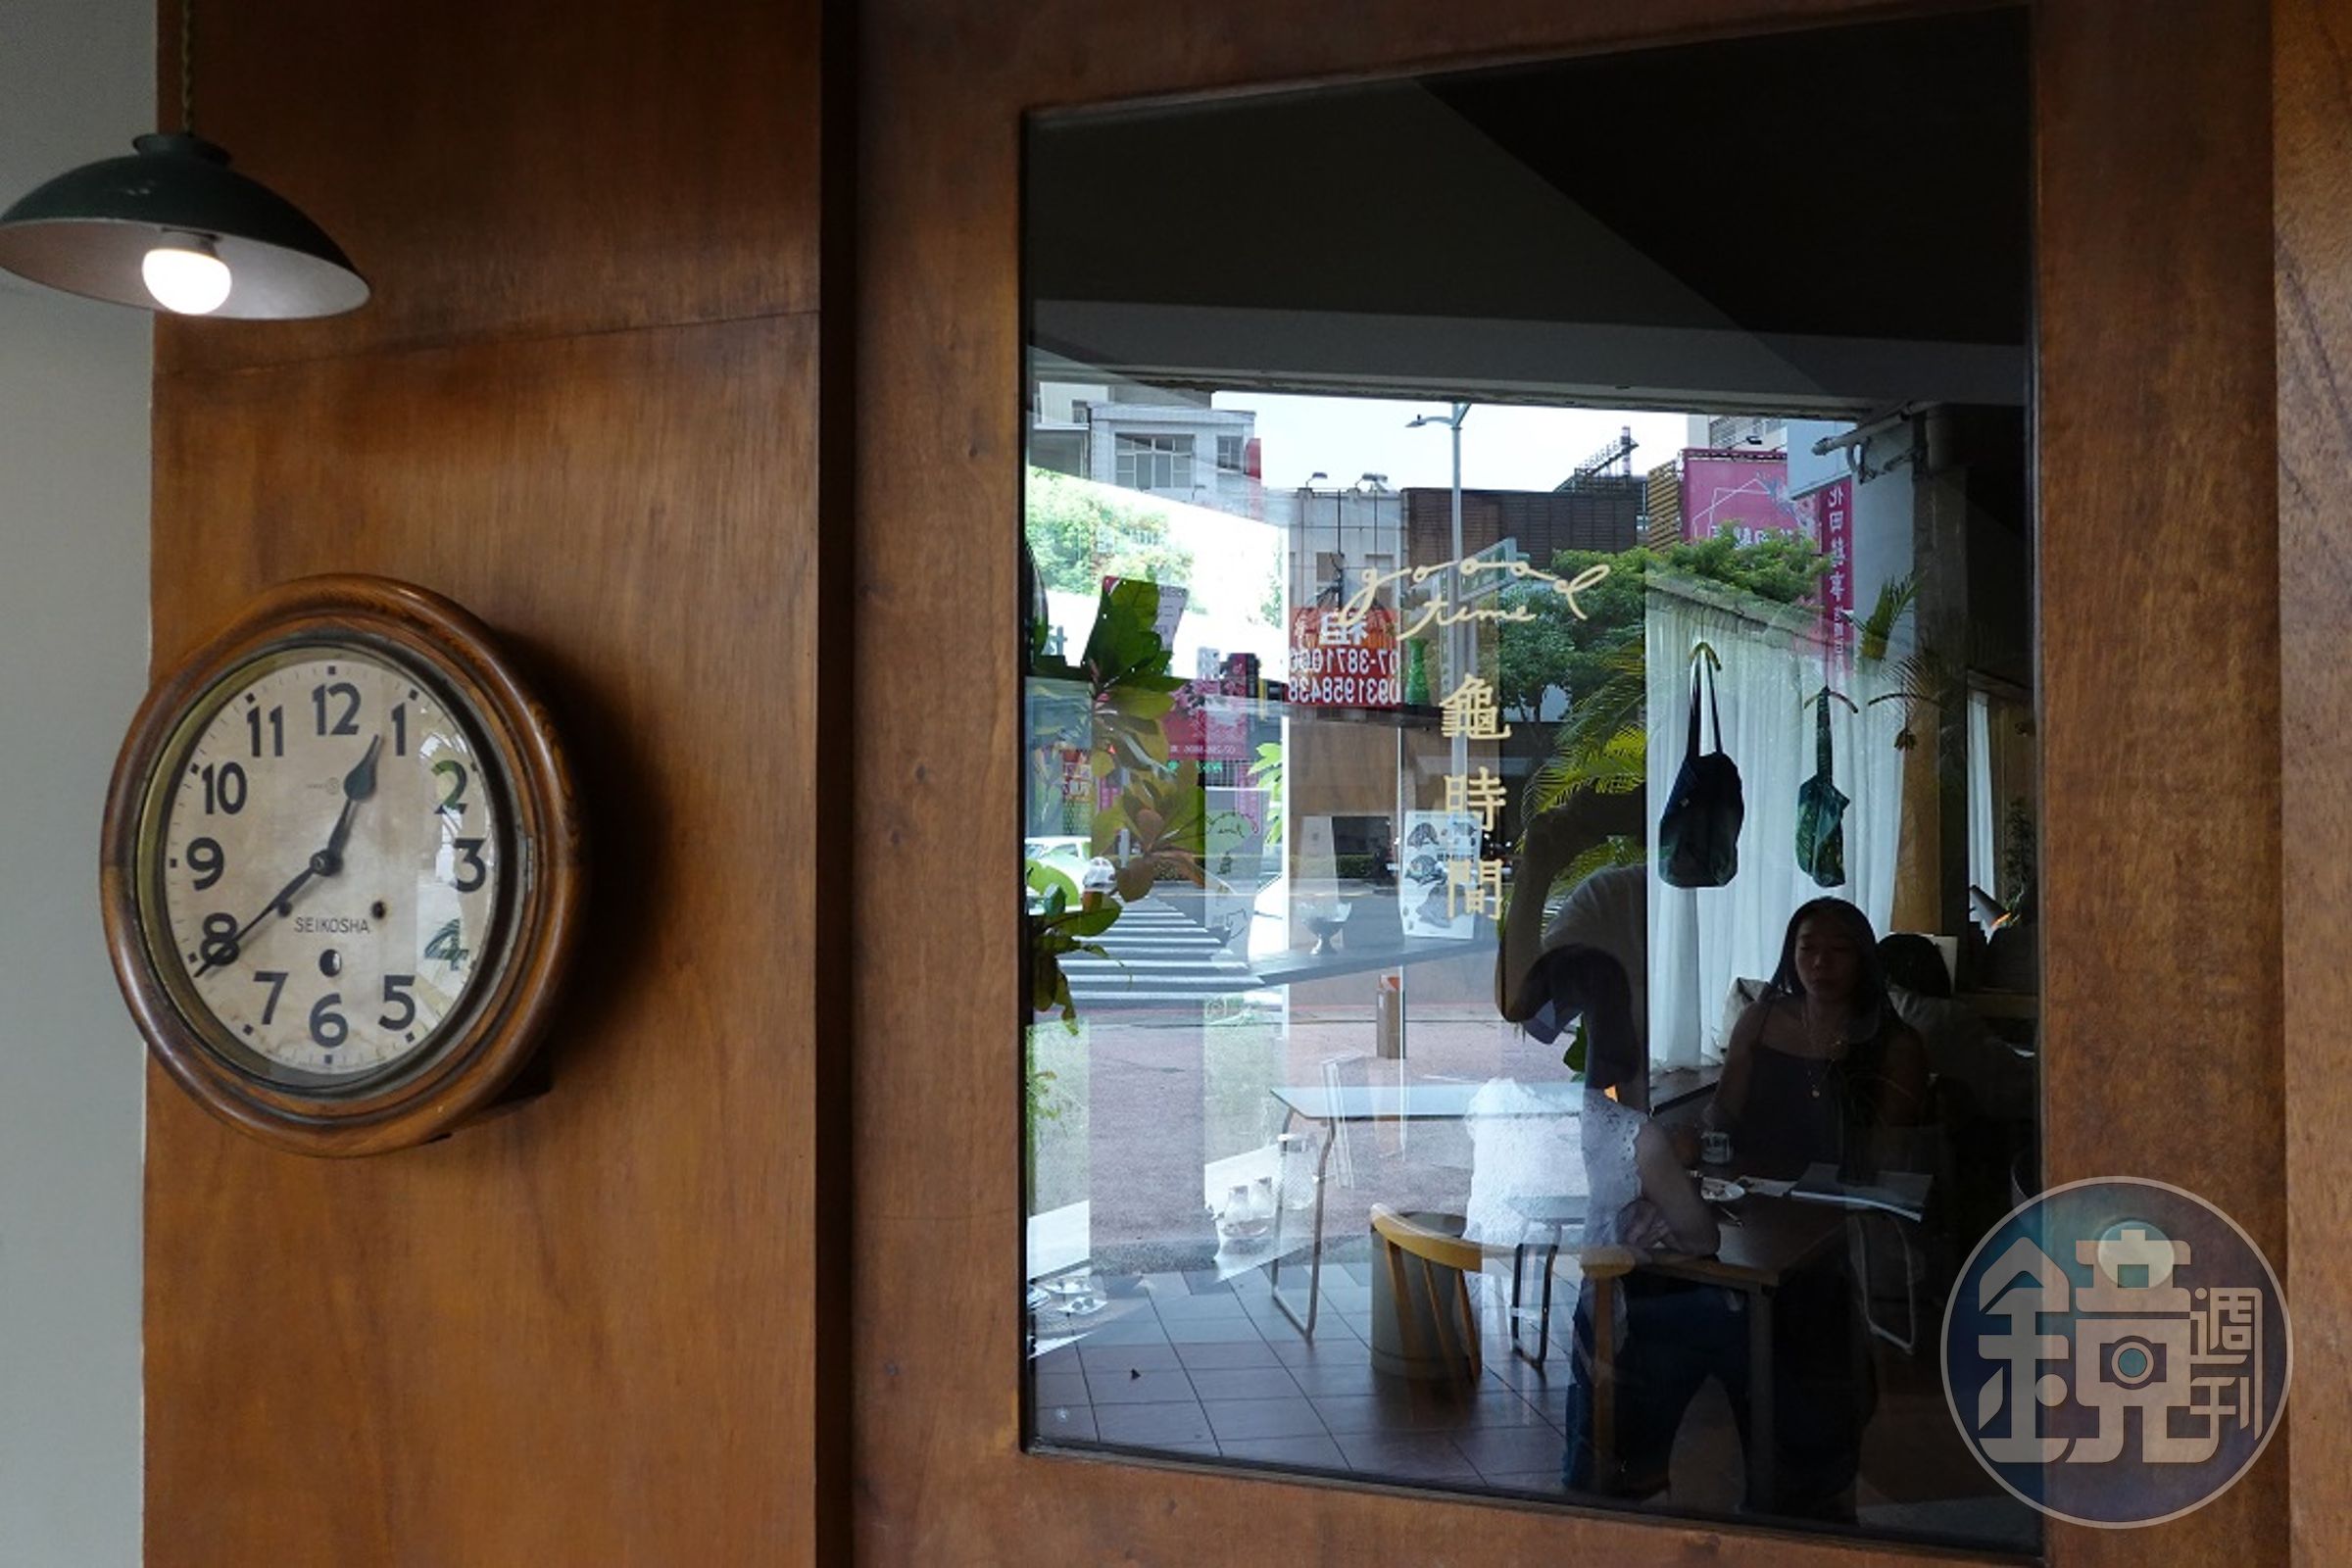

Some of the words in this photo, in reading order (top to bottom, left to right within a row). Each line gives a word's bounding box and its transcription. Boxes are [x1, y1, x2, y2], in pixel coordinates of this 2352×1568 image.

[1338, 564, 1610, 627] good
[1397, 600, 1537, 641] time
[247, 702, 284, 758] 11
[313, 683, 361, 736] 12
[392, 703, 406, 757] 1
[202, 761, 248, 814] 10
[431, 760, 467, 814] 2
[186, 837, 224, 890] 9
[454, 838, 486, 892] 3
[200, 912, 240, 965] 8
[295, 917, 370, 934] SEIKOSHA
[424, 919, 468, 971] 4
[253, 971, 288, 1025] 7
[310, 994, 349, 1048] 6
[378, 975, 416, 1030] 5
